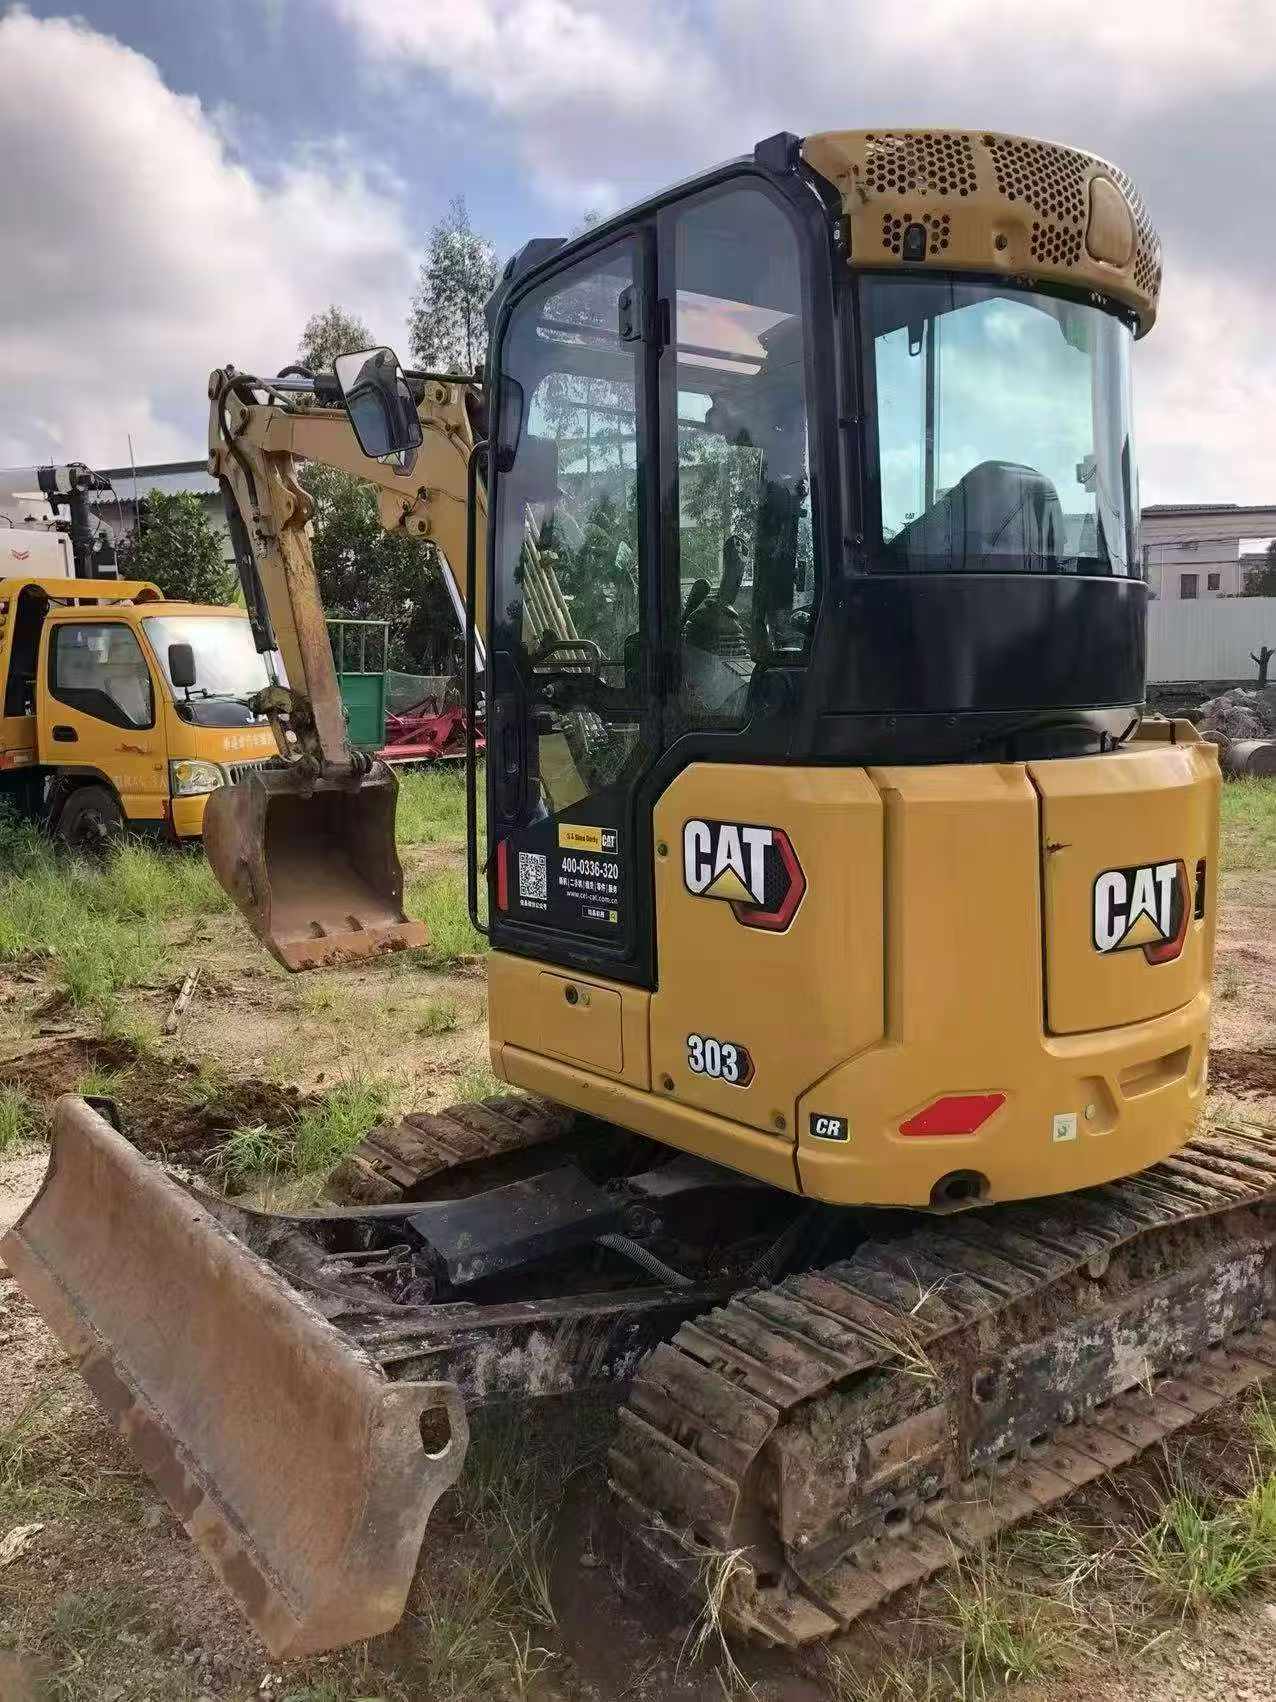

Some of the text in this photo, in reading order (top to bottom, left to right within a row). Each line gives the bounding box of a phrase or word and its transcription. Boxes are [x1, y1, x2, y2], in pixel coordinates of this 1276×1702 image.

[602, 834, 615, 848] CAT
[561, 857, 618, 879] 400-0336-320
[684, 819, 773, 905] CAT
[1094, 861, 1178, 953] CAT
[687, 1033, 739, 1082] 303
[816, 1118, 841, 1136] CR
